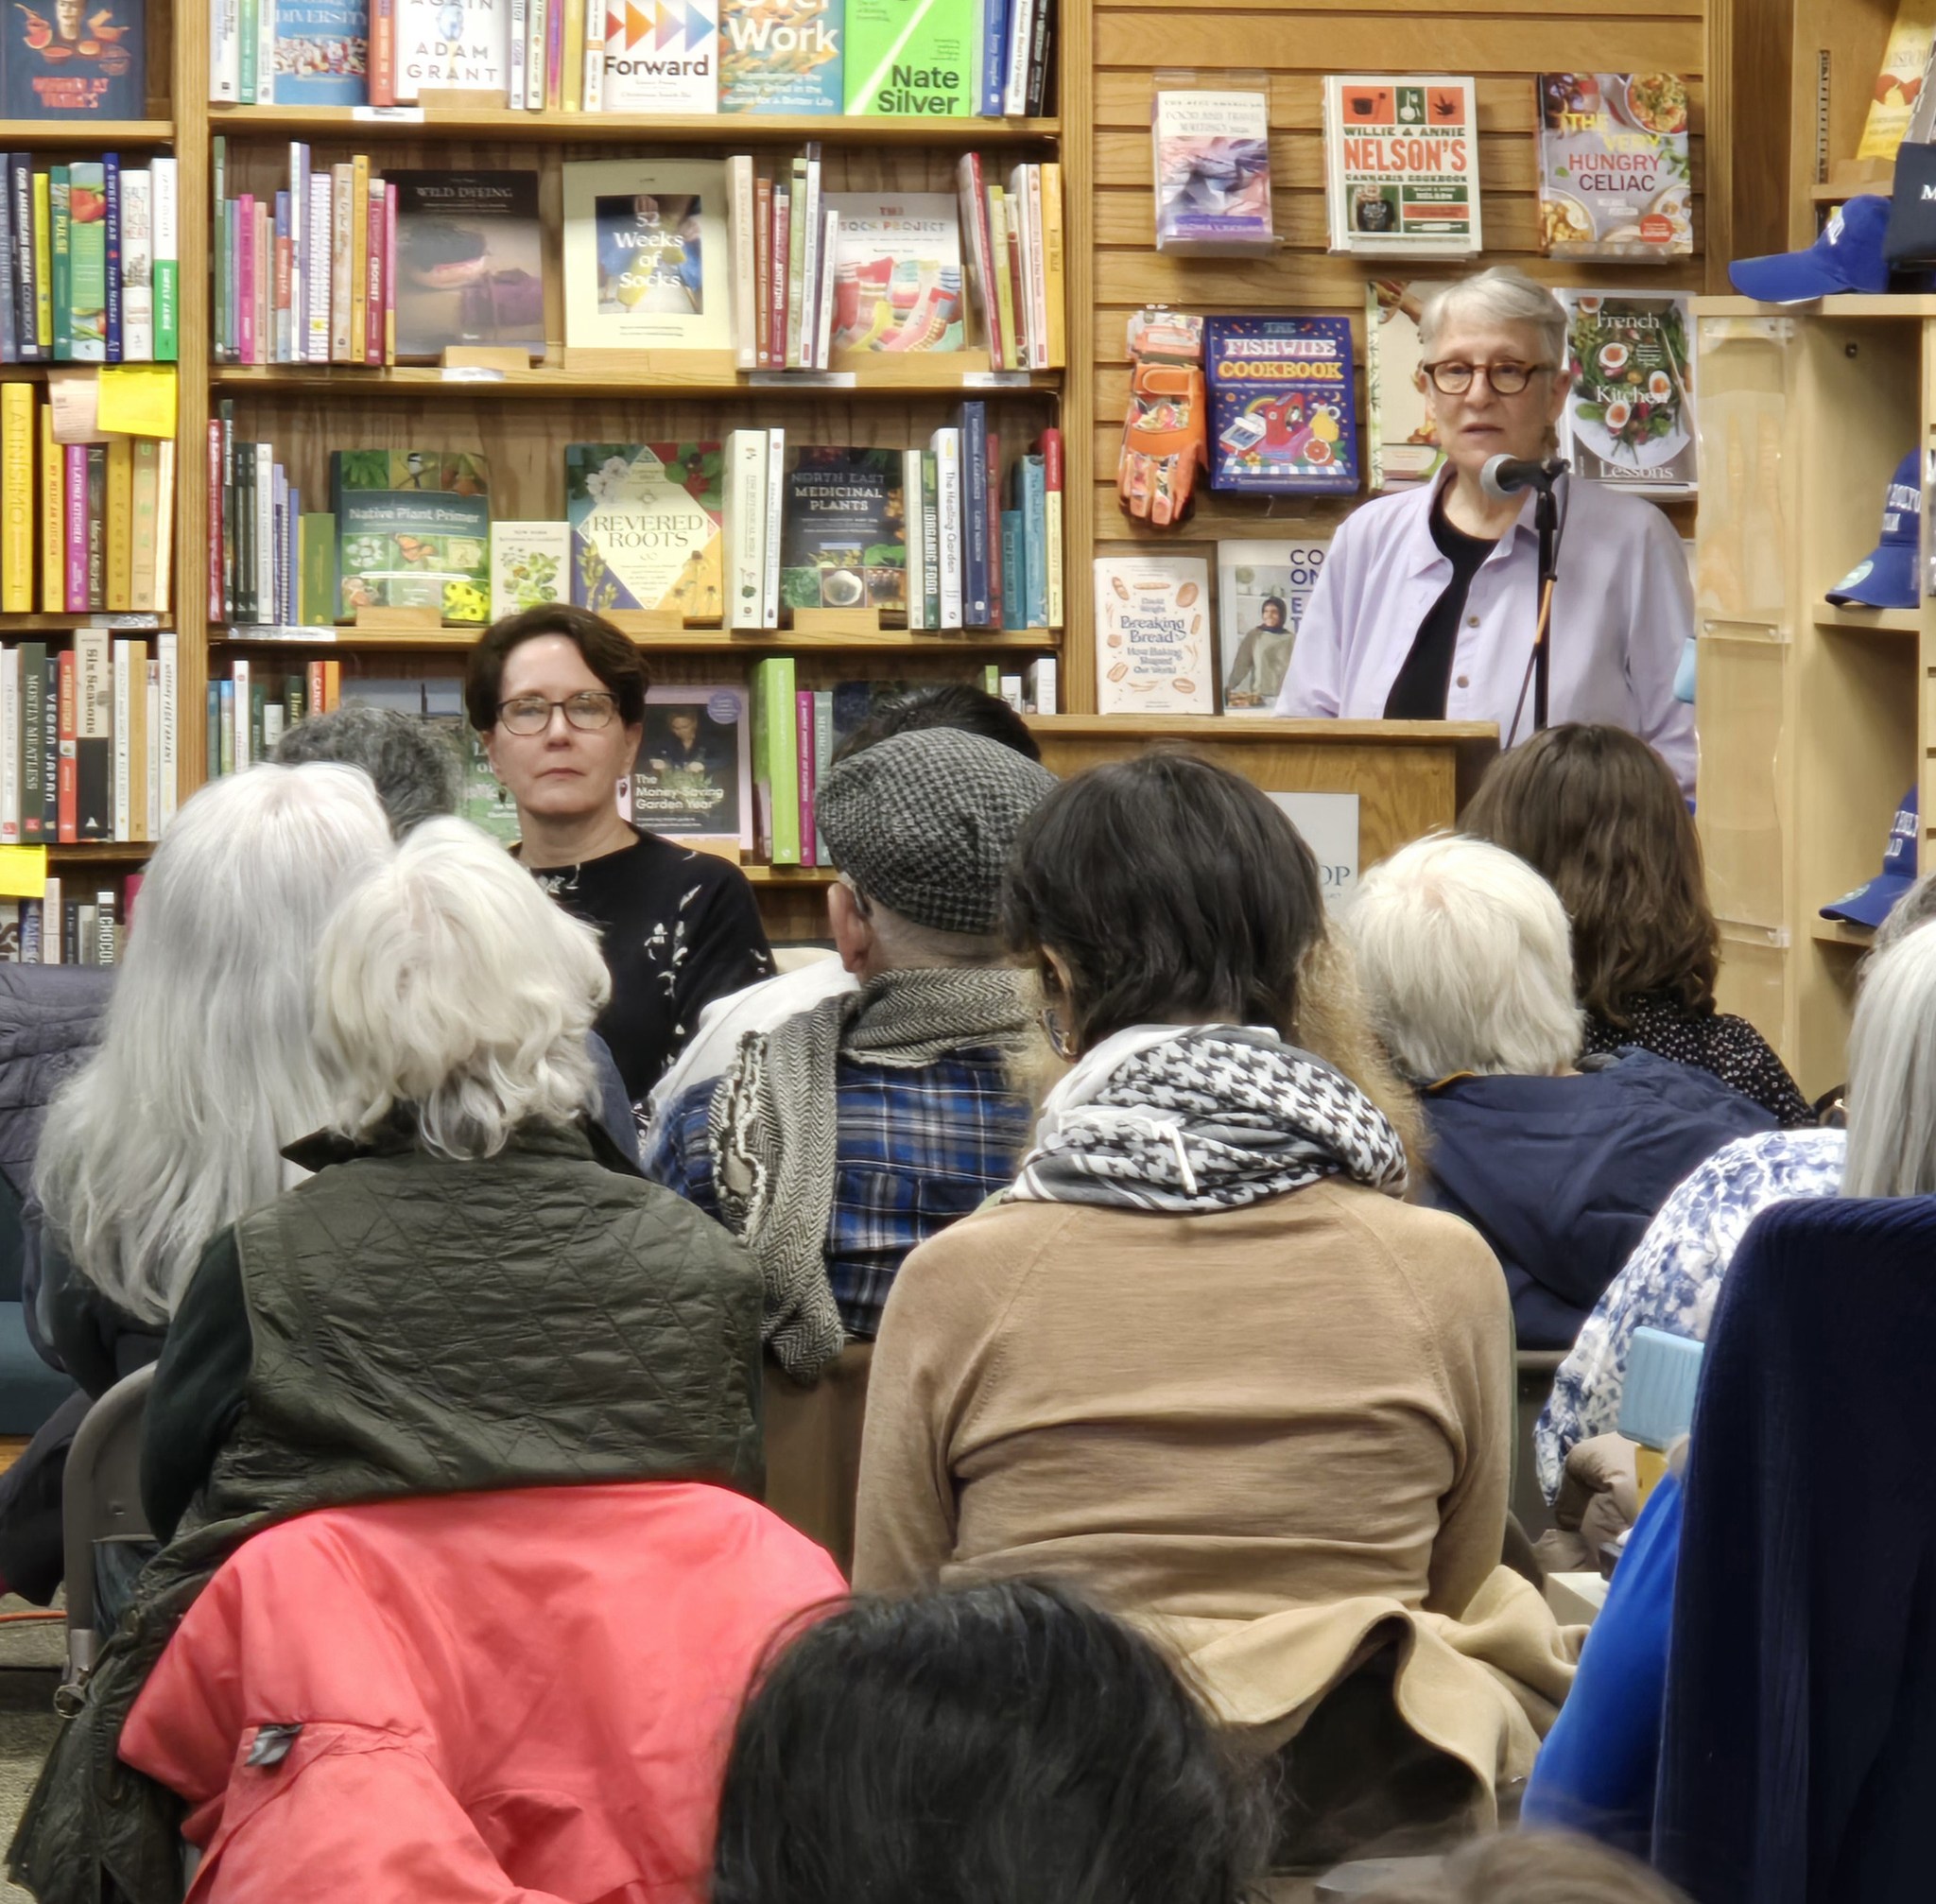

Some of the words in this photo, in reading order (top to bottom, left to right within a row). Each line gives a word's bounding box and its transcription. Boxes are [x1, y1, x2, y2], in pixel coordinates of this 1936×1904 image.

[728, 17, 839, 54] Work
[416, 42, 489, 59] ADAM
[406, 64, 498, 82] GRANT
[604, 54, 710, 77] Forward
[891, 64, 959, 89] Nate
[877, 89, 959, 115] Silver
[1342, 127, 1396, 137] WILLIE
[1419, 127, 1467, 137] ANNIE
[1564, 113, 1610, 133] THE
[1601, 133, 1662, 152] VERY
[1343, 138, 1468, 172] NELSON'S
[1567, 153, 1663, 172] HUNGRY
[1345, 174, 1405, 182] CANNABIS
[1579, 173, 1656, 192] CELIAC
[416, 186, 458, 198] WILD
[1921, 184, 1936, 200] M
[18, 189, 29, 245] AMERICAN
[840, 220, 878, 232] SOCK
[882, 220, 946, 233] PROJECT
[55, 215, 68, 254] PULSE
[613, 231, 684, 249] Weeks
[21, 247, 31, 284] DREAM
[639, 250, 663, 268] of
[370, 256, 379, 302] CROCHET
[619, 271, 683, 289] Socks
[1596, 311, 1662, 332] French
[1223, 338, 1339, 357] FISHWIFE
[1218, 360, 1344, 381] COOKBOOK
[1596, 385, 1669, 405] Kitchen
[790, 472, 845, 484] NORTH
[849, 473, 886, 483] EAST
[1599, 458, 1675, 479] Lessons
[945, 471, 956, 488] The
[794, 486, 885, 499] MEDICINAL
[348, 508, 395, 521] Native
[396, 507, 436, 521] Plant
[437, 508, 481, 523] Primer
[809, 500, 870, 511] PLANTS
[943, 491, 956, 529] Healing
[73, 501, 82, 545] KITCHEN
[594, 513, 703, 532] REVERED
[609, 531, 690, 549] ROOTS
[946, 532, 957, 573] Garden
[925, 565, 937, 595] FOOD
[1120, 615, 1185, 636] Breaking
[1130, 629, 1175, 645] Bread
[86, 649, 98, 671] Six
[1150, 647, 1184, 661] Baking
[26, 674, 39, 724] MOSTLY
[86, 674, 98, 734] Seasons
[46, 693, 57, 745] VEGAN
[26, 726, 39, 790] MEATLESS
[46, 753, 57, 803] JAPAN
[634, 773, 658, 785] The
[635, 799, 684, 810] Garden
[685, 799, 717, 810] Year
